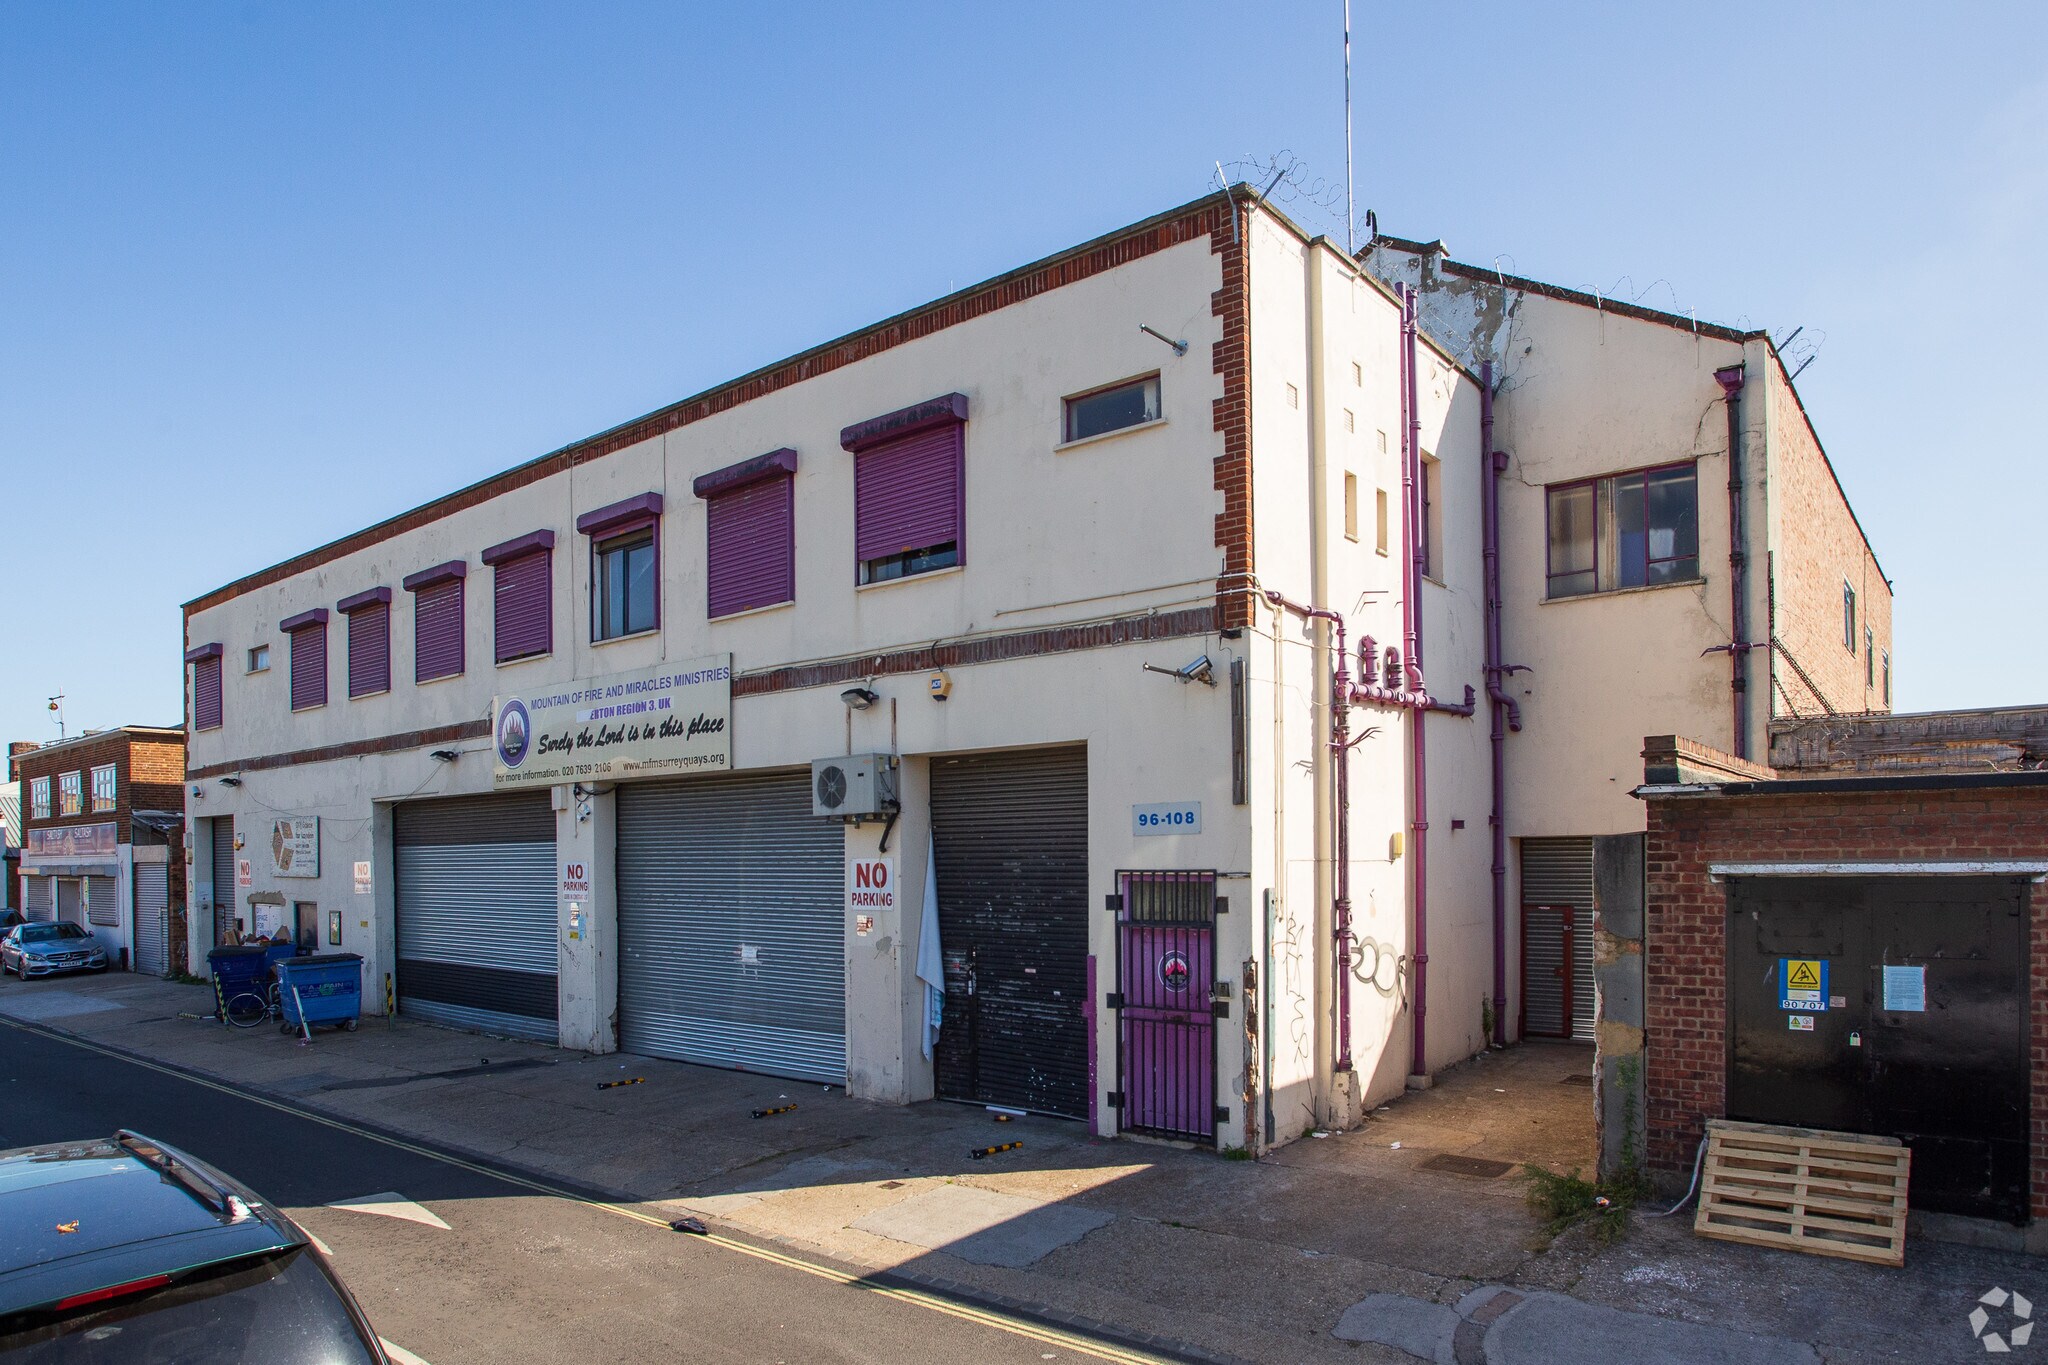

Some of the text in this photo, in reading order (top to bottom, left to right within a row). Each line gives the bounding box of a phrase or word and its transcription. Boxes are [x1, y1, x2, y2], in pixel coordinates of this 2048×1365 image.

[530, 666, 730, 711] MOUNTAIN OF FIRE AND MIRACLES MINISTRIES
[616, 700, 647, 717] REGION
[658, 697, 671, 710] UK
[537, 712, 725, 756] Surely the Lord is in this place
[495, 753, 725, 783] for more information. 020 7639 2106 www.mfmsurreyquays.org
[1138, 811, 1195, 826] 96-108
[240, 862, 250, 876] NO
[357, 863, 369, 876] NO
[567, 864, 583, 880] NO
[856, 862, 887, 889] NO
[563, 881, 588, 892] PARKING
[851, 892, 892, 907] PARKING
